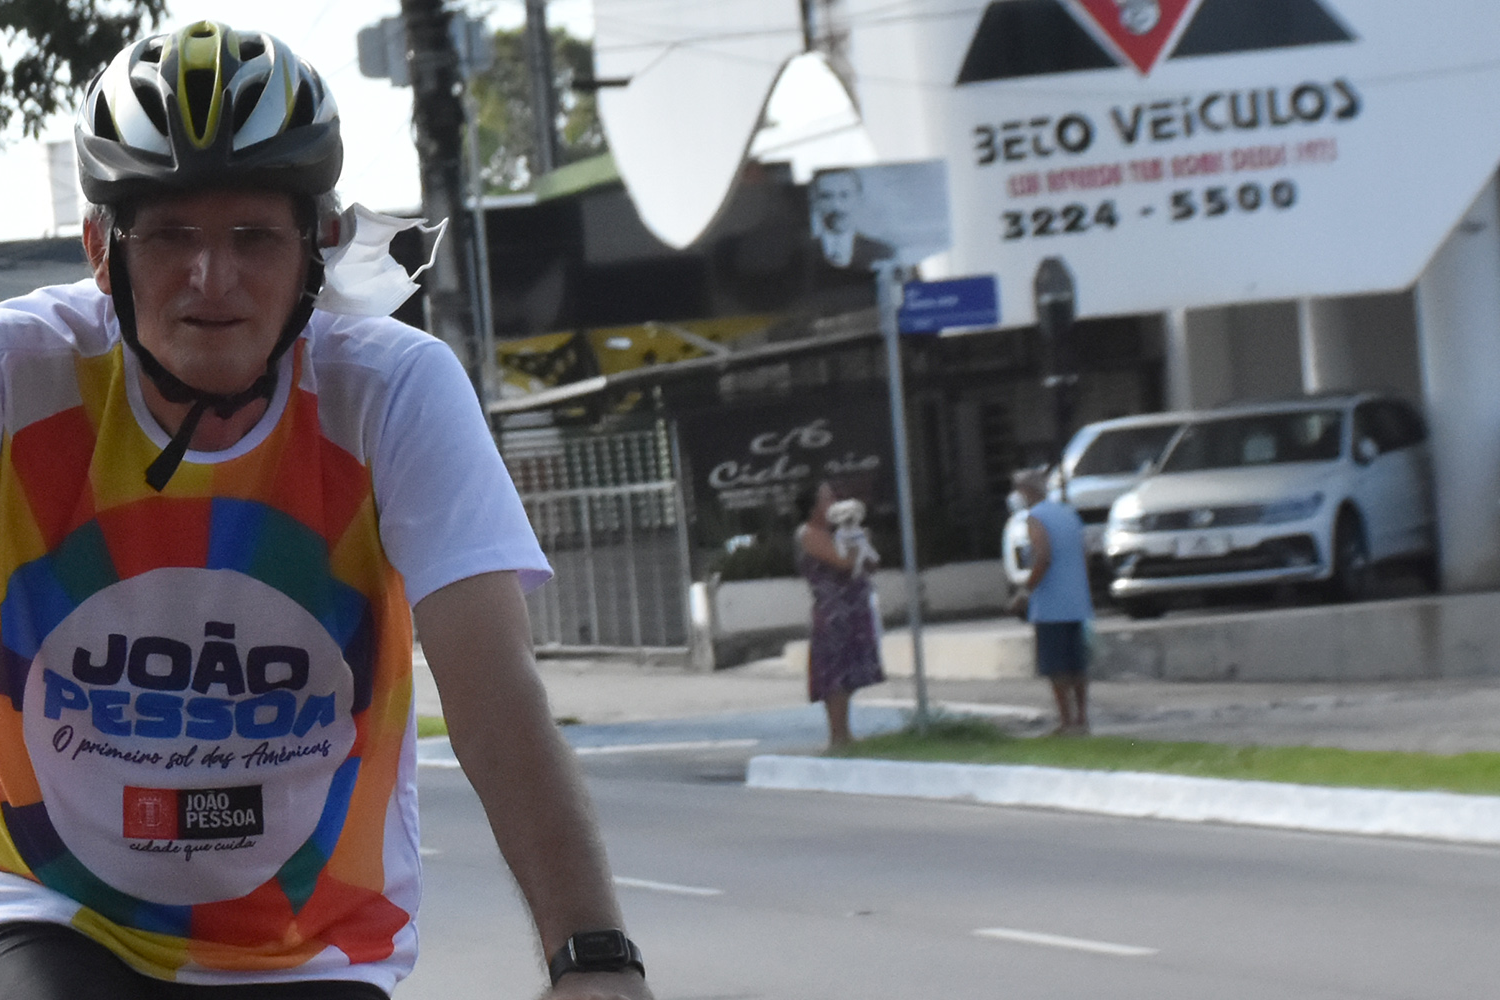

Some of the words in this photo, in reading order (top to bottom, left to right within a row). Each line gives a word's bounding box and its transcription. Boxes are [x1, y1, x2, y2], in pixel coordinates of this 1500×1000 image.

[1001, 199, 1118, 241] 3224
[1169, 179, 1297, 221] 5500
[72, 621, 309, 696] JOÃO
[43, 668, 336, 741] PESSOA
[52, 725, 74, 753] O
[72, 738, 163, 764] primeiro
[165, 744, 198, 770] sol
[200, 745, 235, 769] das
[241, 739, 332, 769] Américas
[186, 790, 230, 811] JOÃO
[186, 808, 257, 829] PESSOA
[129, 839, 181, 853] cidade
[183, 843, 212, 861] que
[214, 836, 257, 851] cuida
